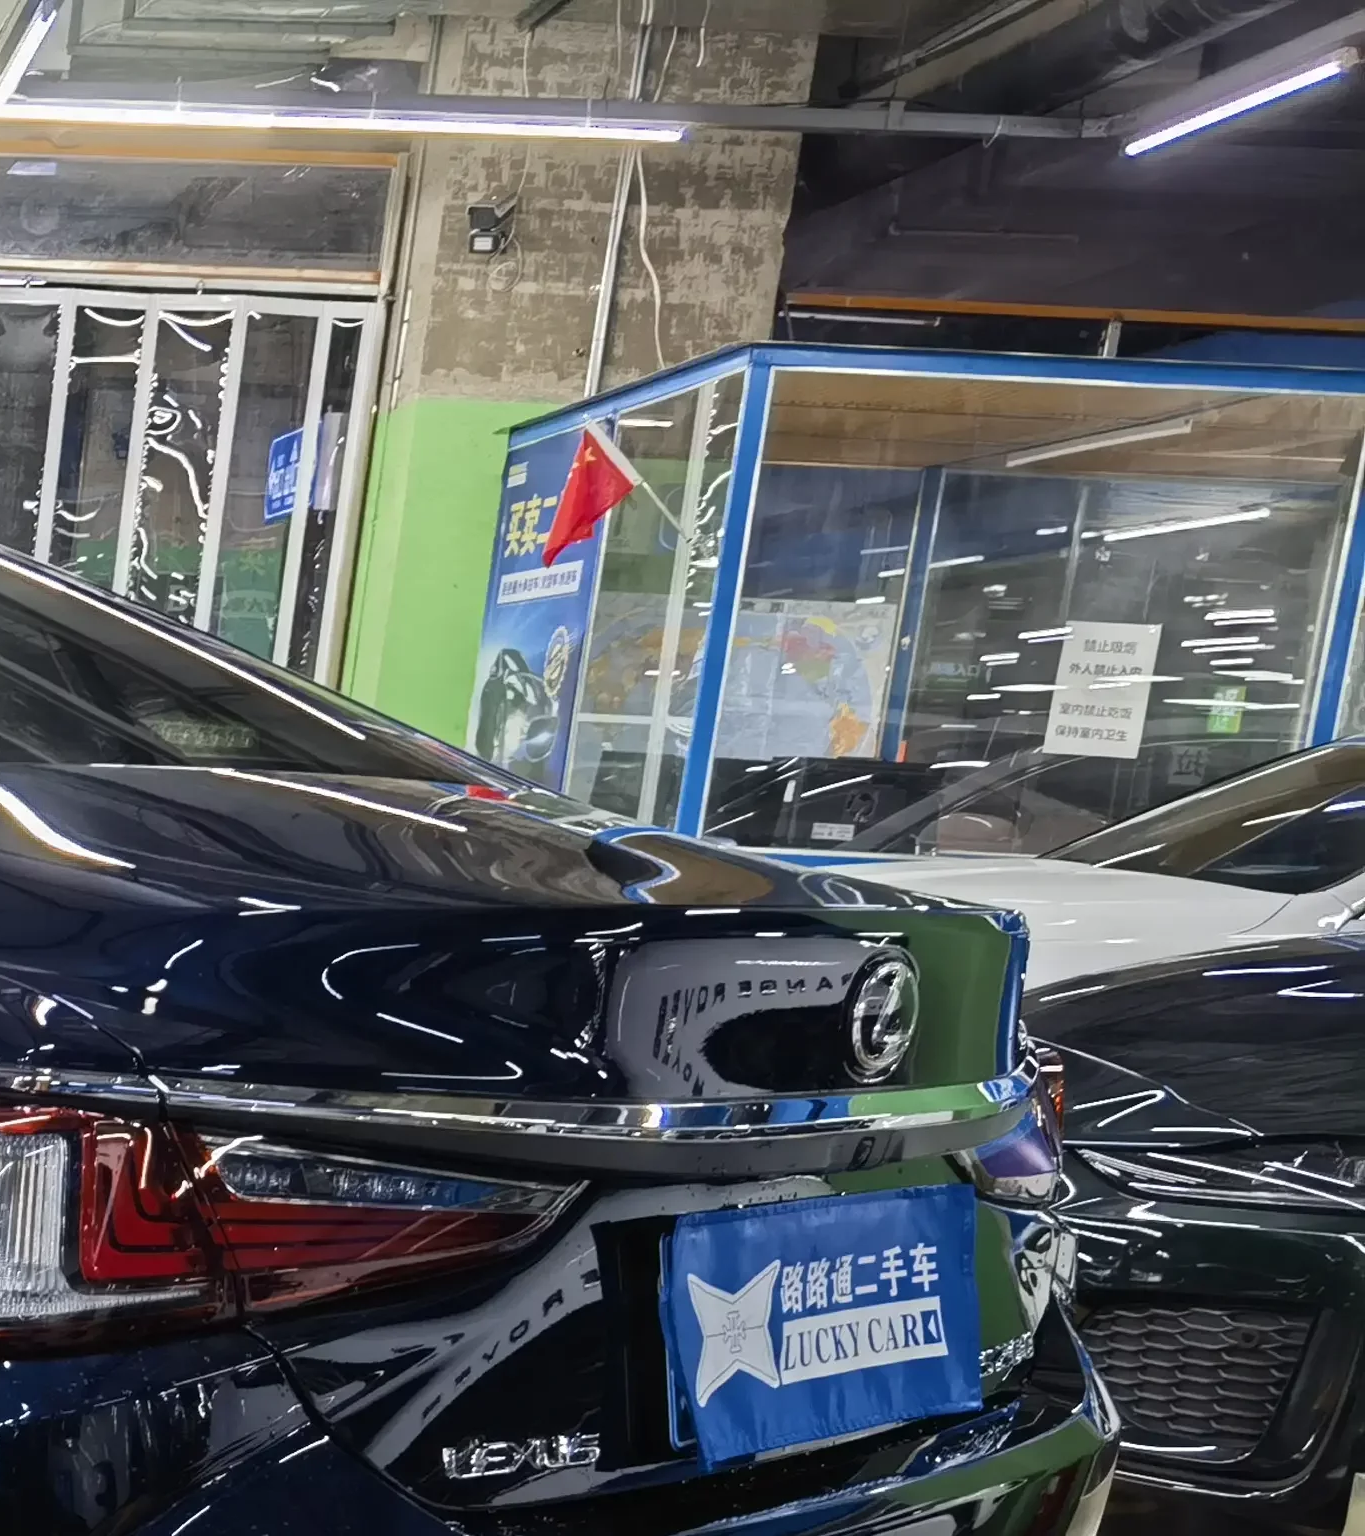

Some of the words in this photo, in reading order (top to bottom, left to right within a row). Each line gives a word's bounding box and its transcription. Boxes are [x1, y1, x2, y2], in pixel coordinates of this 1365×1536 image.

[1083, 639, 1138, 655] 禁止吸烟
[1069, 662, 1143, 676] 外人禁止入内
[1055, 725, 1128, 741] 保持室内卫生
[780, 1243, 939, 1314] 路路通二手车
[783, 1321, 861, 1372] LUCKY
[867, 1312, 921, 1351] CAR
[442, 1432, 601, 1480] LEXUS
